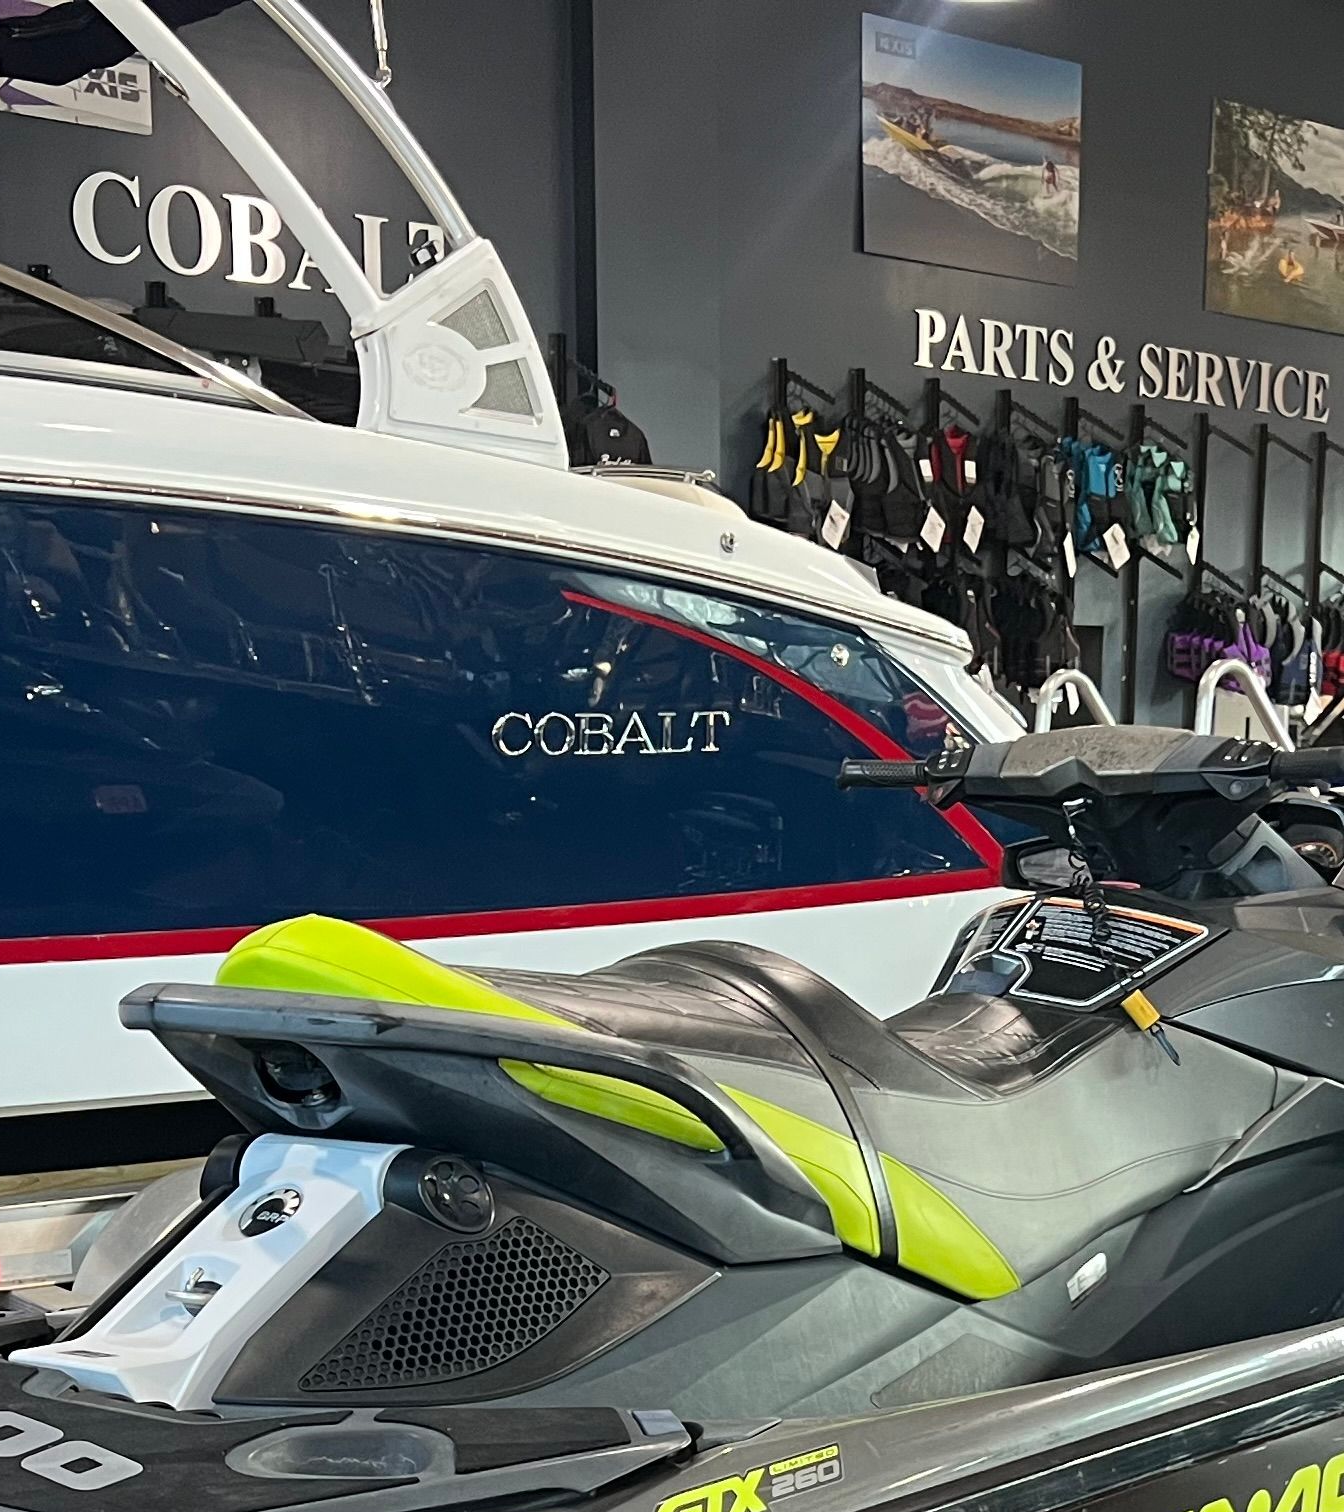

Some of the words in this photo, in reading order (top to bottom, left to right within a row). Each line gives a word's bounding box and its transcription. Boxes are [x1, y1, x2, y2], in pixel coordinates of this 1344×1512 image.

[83, 68, 141, 103] XIS
[913, 308, 1075, 386] PARTS
[1087, 336, 1126, 393] &
[1138, 343, 1331, 424] SERVICE
[492, 711, 731, 756] COBALT
[771, 1459, 841, 1498] 260
[772, 1447, 836, 1474] LIMITED
